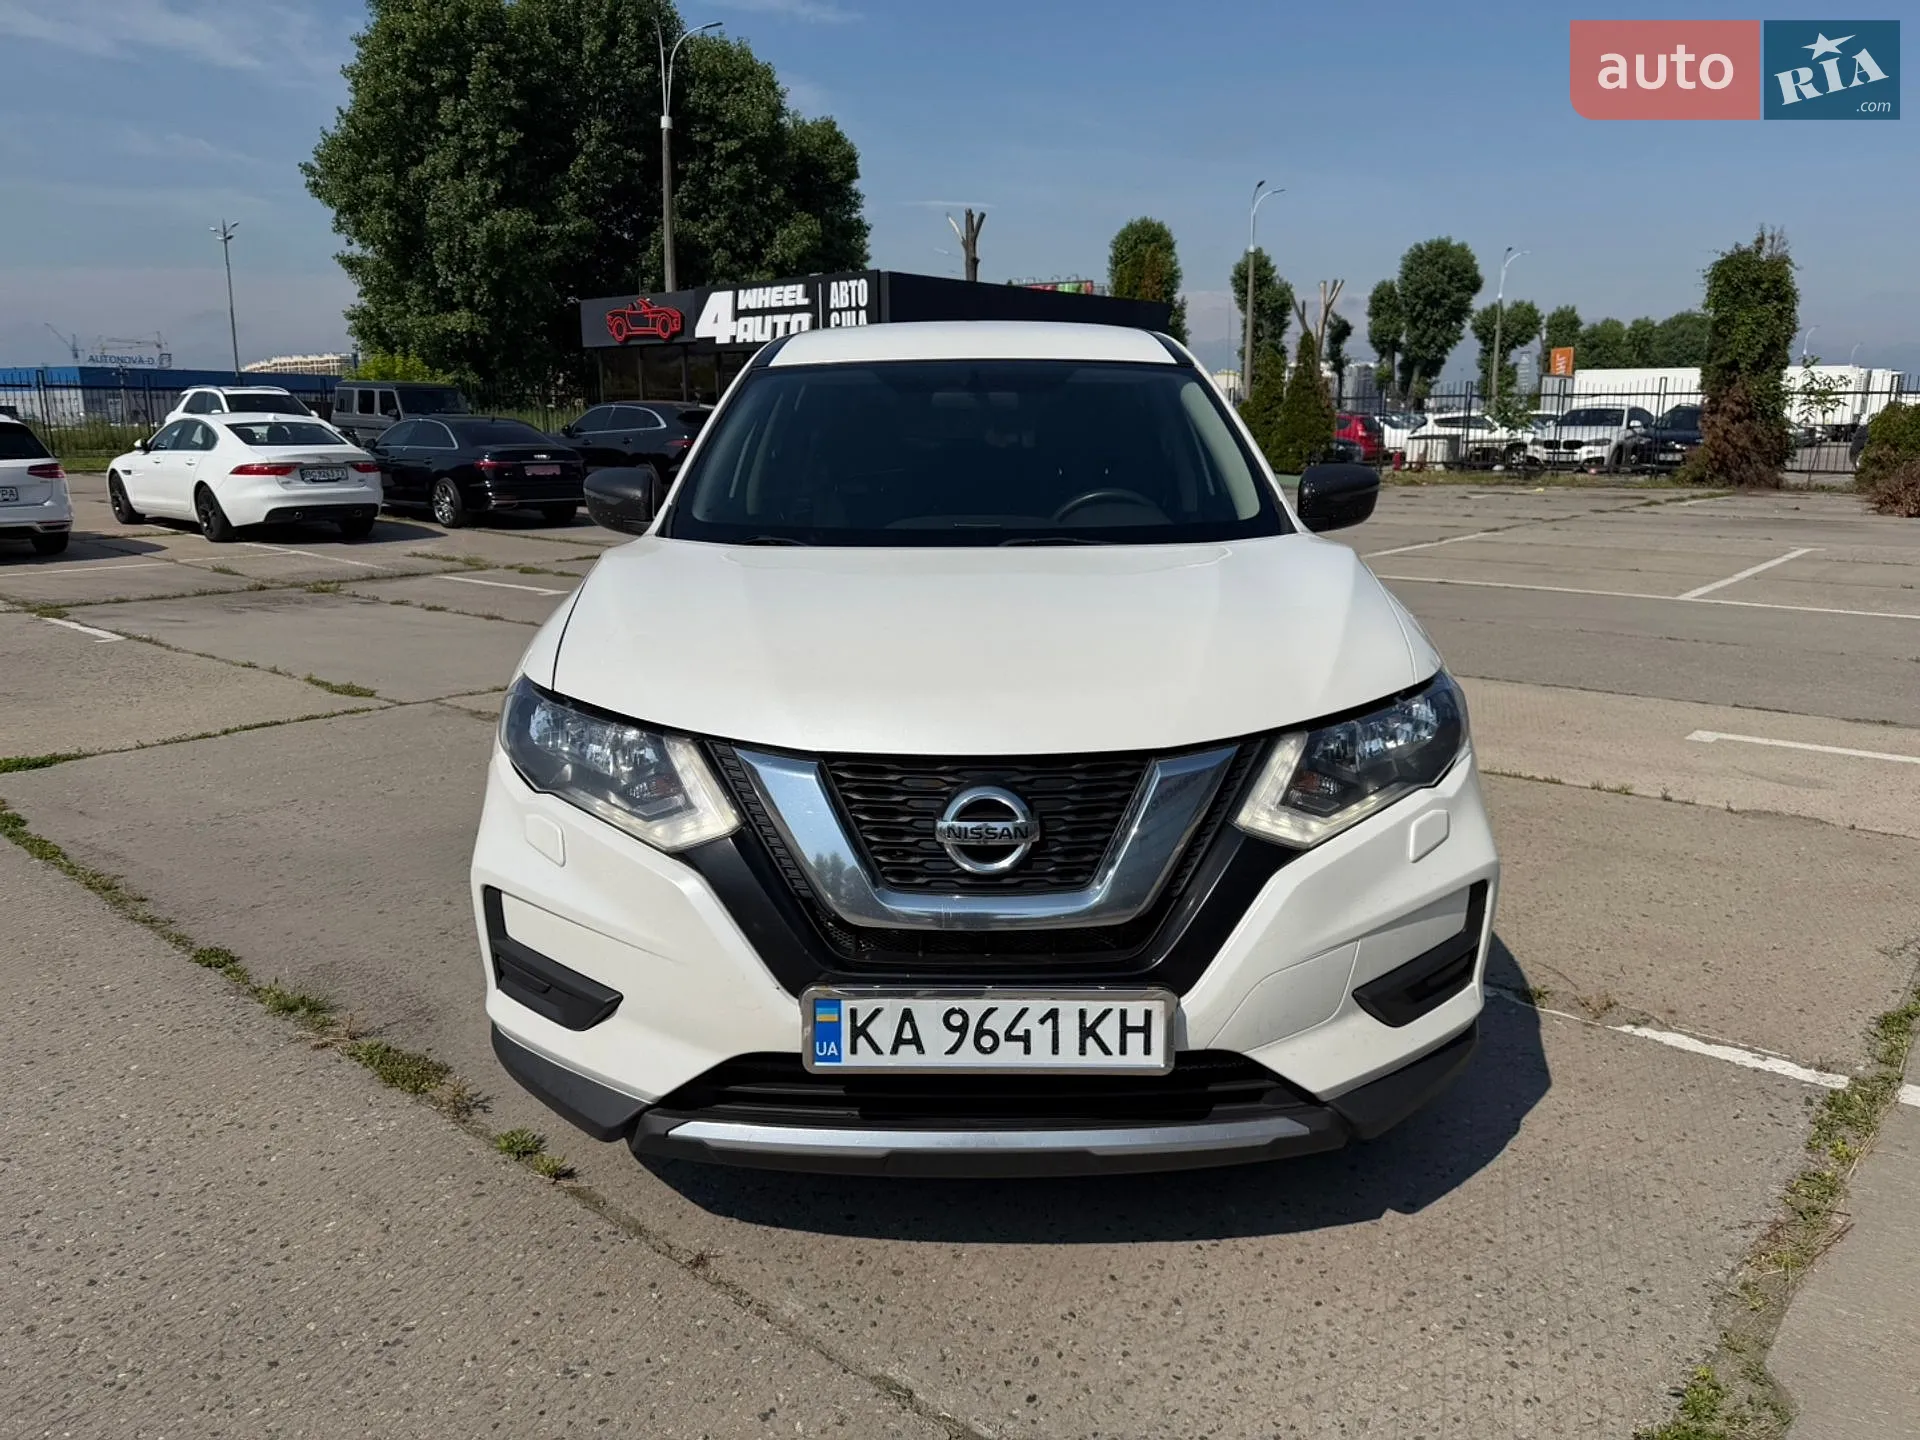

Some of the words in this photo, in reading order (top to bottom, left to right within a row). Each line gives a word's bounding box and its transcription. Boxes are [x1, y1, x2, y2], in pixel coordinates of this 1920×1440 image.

[737, 284, 810, 310] WHEEL
[829, 278, 868, 309] АВТО
[695, 290, 737, 344] 4
[736, 312, 812, 343] AUTO
[946, 826, 1029, 840] NISSAN
[816, 1041, 838, 1057] UA
